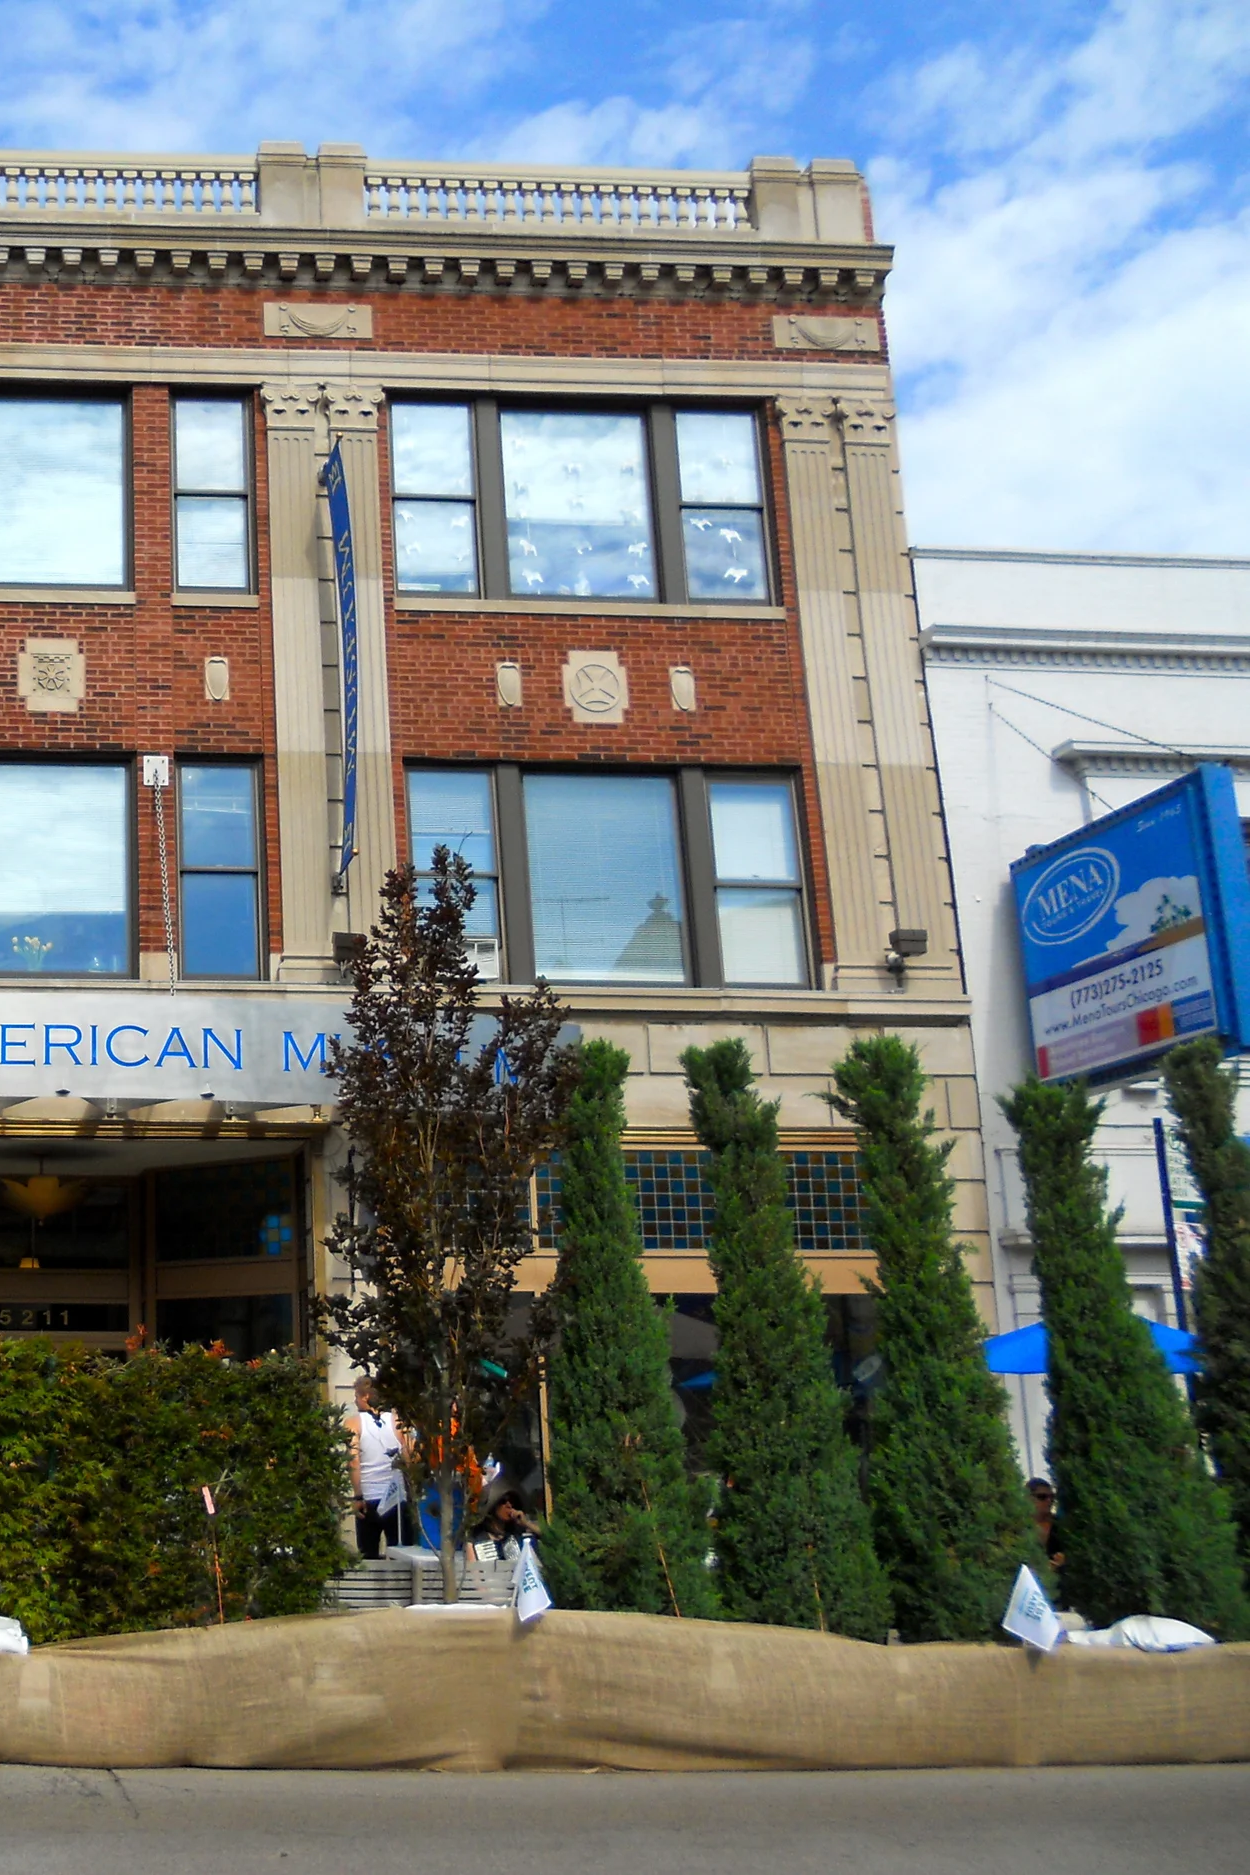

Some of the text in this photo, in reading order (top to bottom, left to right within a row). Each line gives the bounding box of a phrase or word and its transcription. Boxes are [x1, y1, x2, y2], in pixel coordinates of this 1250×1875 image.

[1037, 863, 1104, 921] MENA
[1044, 975, 1199, 1035] www.MenaToursChicago.com
[1070, 958, 1164, 1009] (773)275-2125
[0, 1308, 70, 1326] 5211
